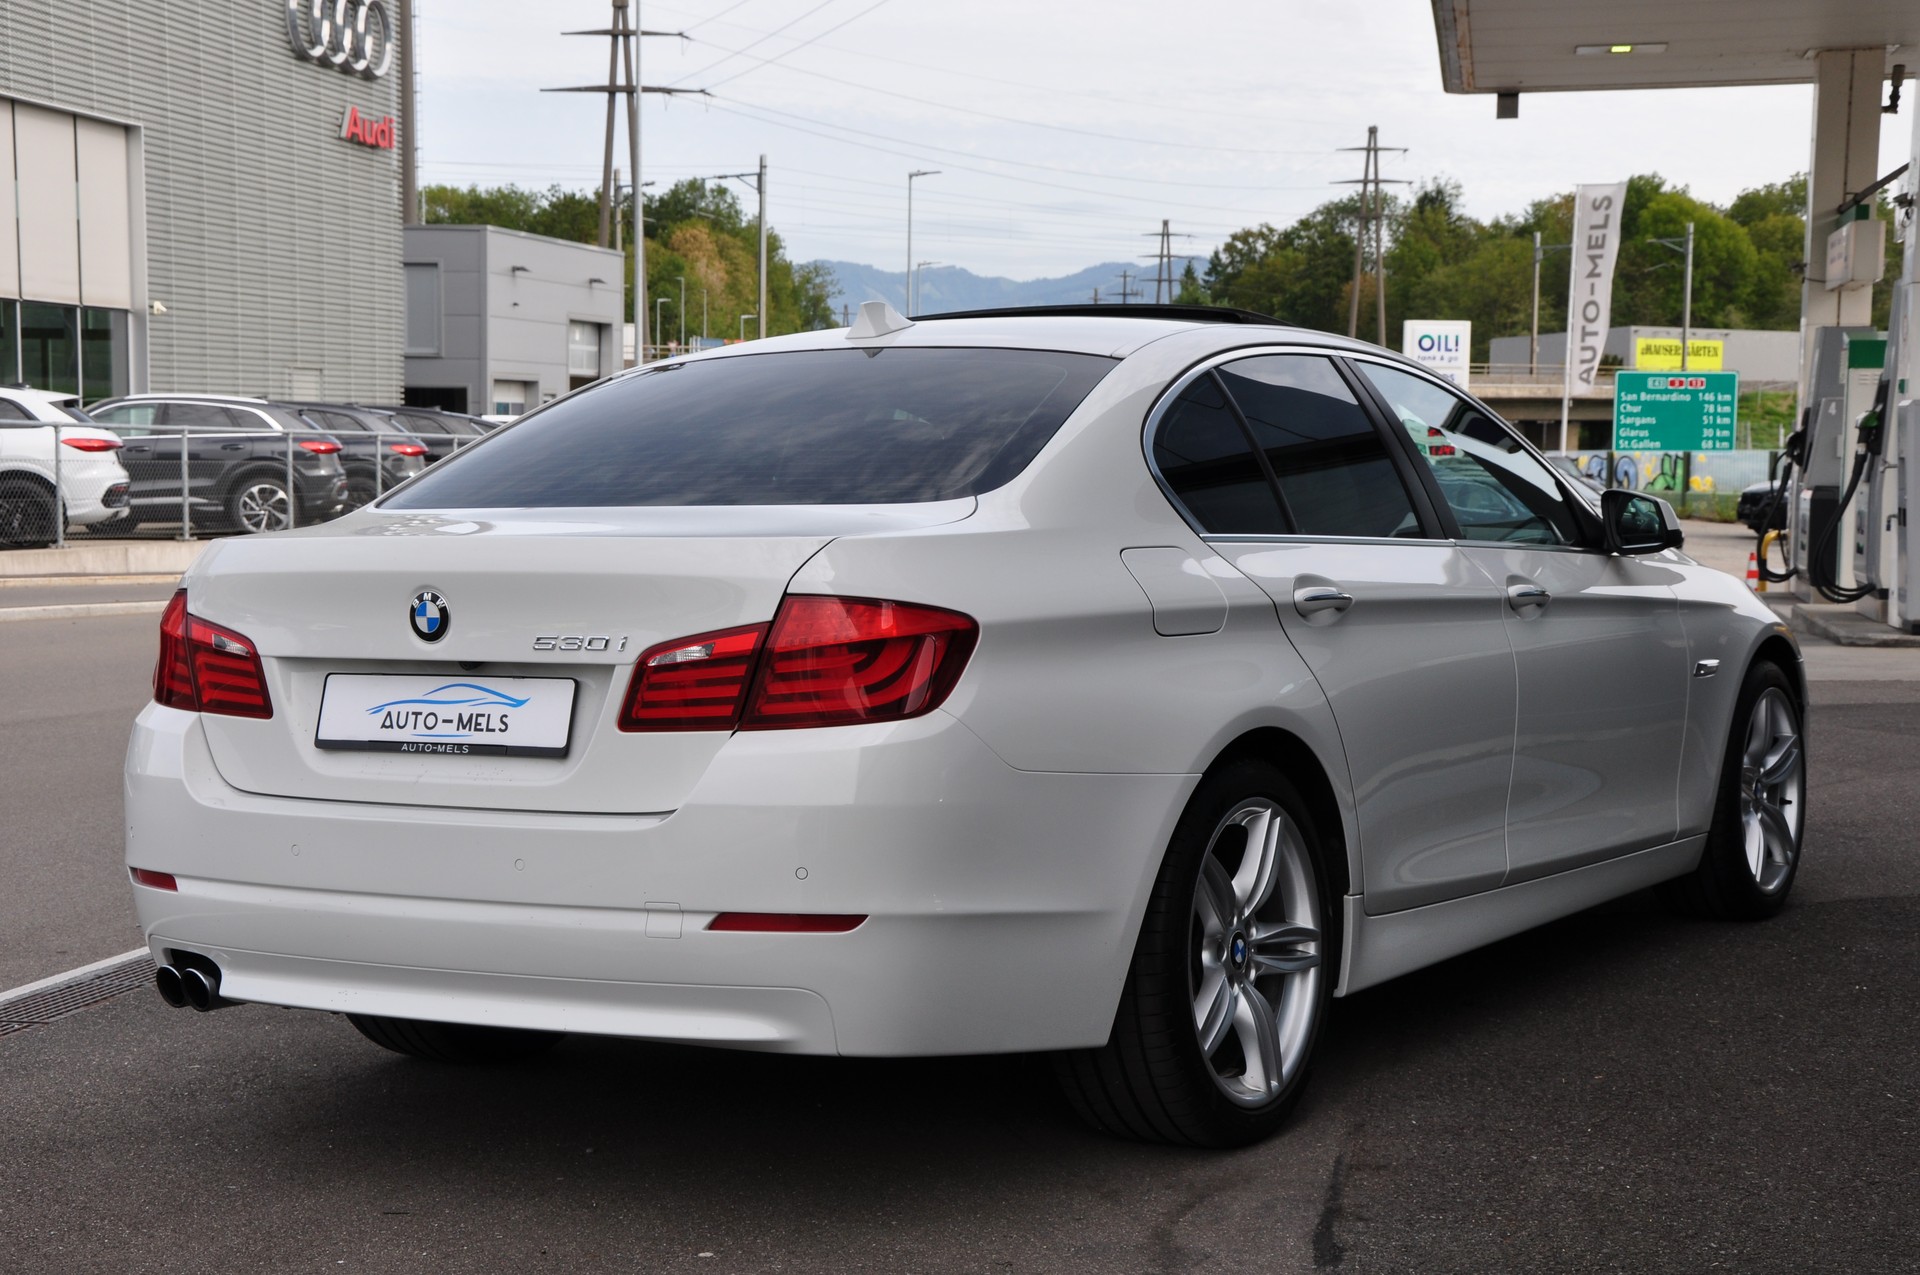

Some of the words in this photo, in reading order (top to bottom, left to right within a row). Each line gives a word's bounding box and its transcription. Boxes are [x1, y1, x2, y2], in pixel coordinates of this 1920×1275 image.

[343, 106, 395, 150] Audi
[1578, 195, 1614, 386] AUTO-MELS
[1418, 334, 1459, 352] OIL!
[1620, 392, 1638, 402] San
[1640, 391, 1692, 402] Bernardino
[1698, 392, 1715, 402] 146
[1718, 392, 1732, 402] km
[1620, 403, 1642, 413] Chur
[1704, 403, 1715, 413] 78
[1717, 403, 1731, 413] km
[1620, 415, 1657, 427] Sargans
[1703, 415, 1714, 425] 51
[1716, 415, 1731, 425] km
[1619, 427, 1650, 437] Glarus
[1702, 427, 1714, 437] 30
[1716, 427, 1730, 437] km
[1702, 439, 1714, 449] 68
[1715, 439, 1730, 449] km
[412, 592, 446, 609] BMW
[380, 710, 509, 733] AUTO-MELS
[401, 743, 470, 754] AUTO-MELS
